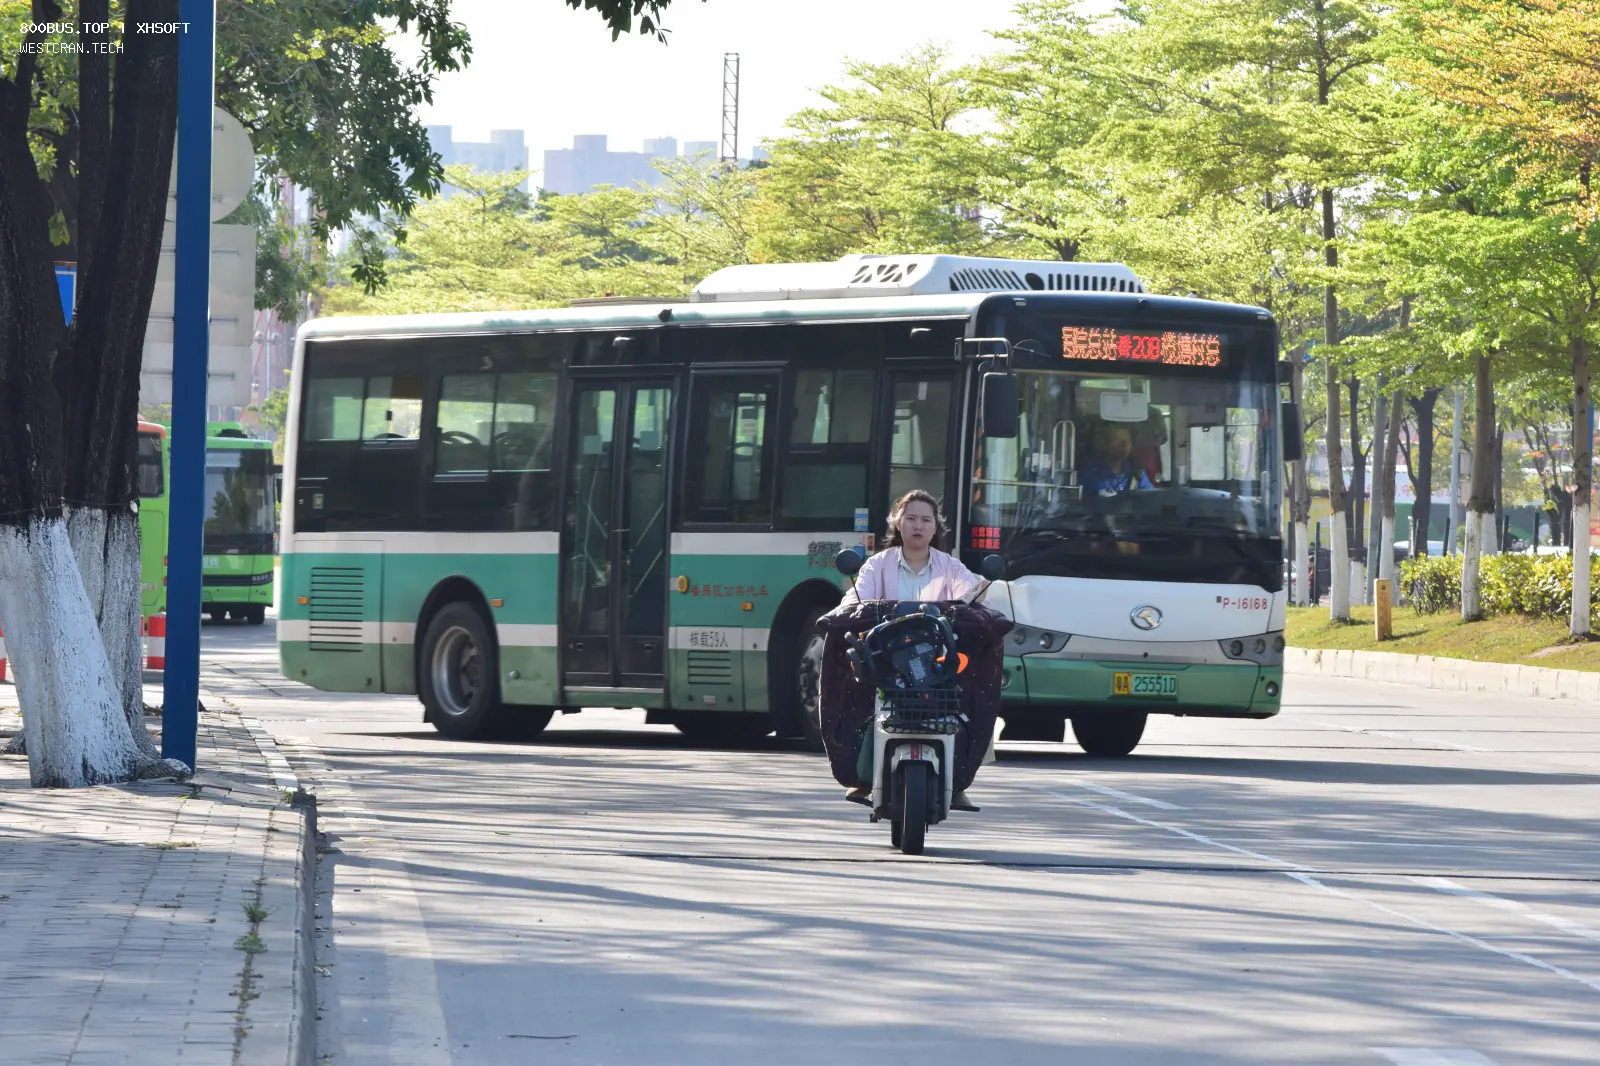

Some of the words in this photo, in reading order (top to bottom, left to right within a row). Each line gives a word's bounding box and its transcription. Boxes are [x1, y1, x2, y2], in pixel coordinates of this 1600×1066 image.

[1222, 598, 1268, 610] P-16168
[690, 631, 729, 648] 核载59人
